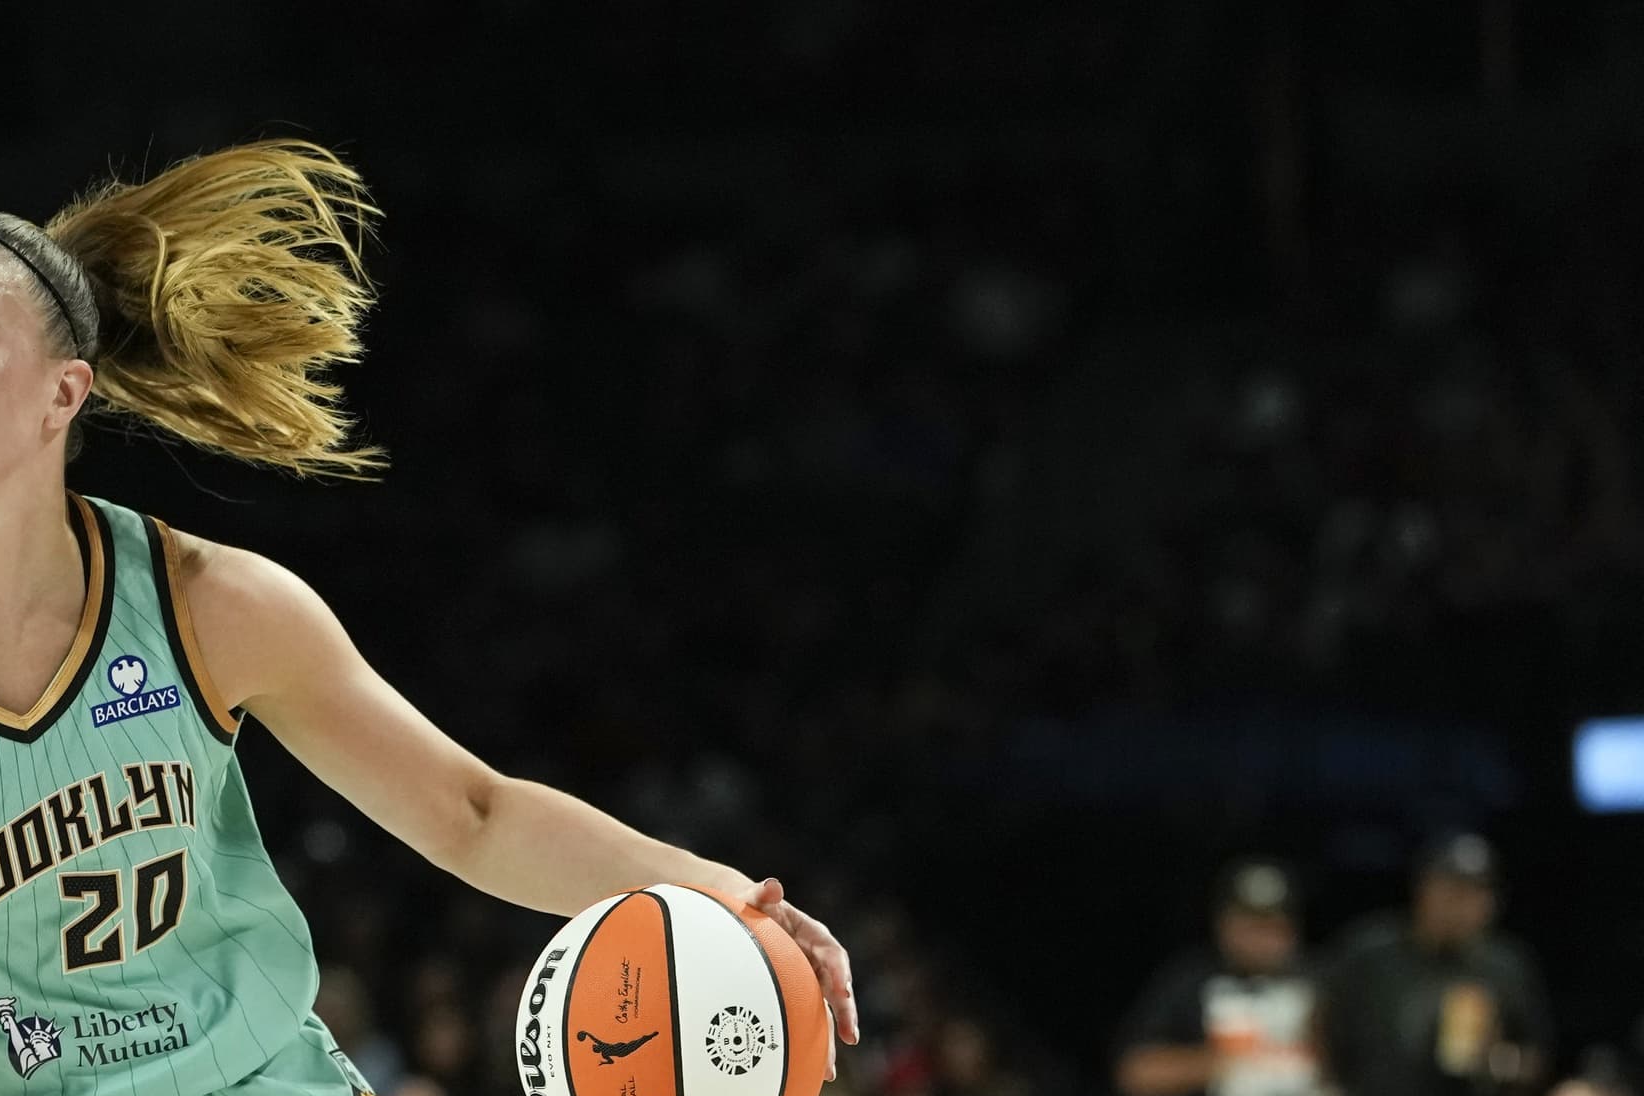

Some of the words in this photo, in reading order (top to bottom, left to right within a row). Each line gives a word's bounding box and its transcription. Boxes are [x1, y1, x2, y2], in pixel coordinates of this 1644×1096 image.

[95, 688, 178, 724] BARCLAYS
[59, 847, 188, 975] 20
[71, 1002, 179, 1039] Liberty
[76, 1025, 191, 1068] Mutual
[547, 1053, 556, 1078] EVO
